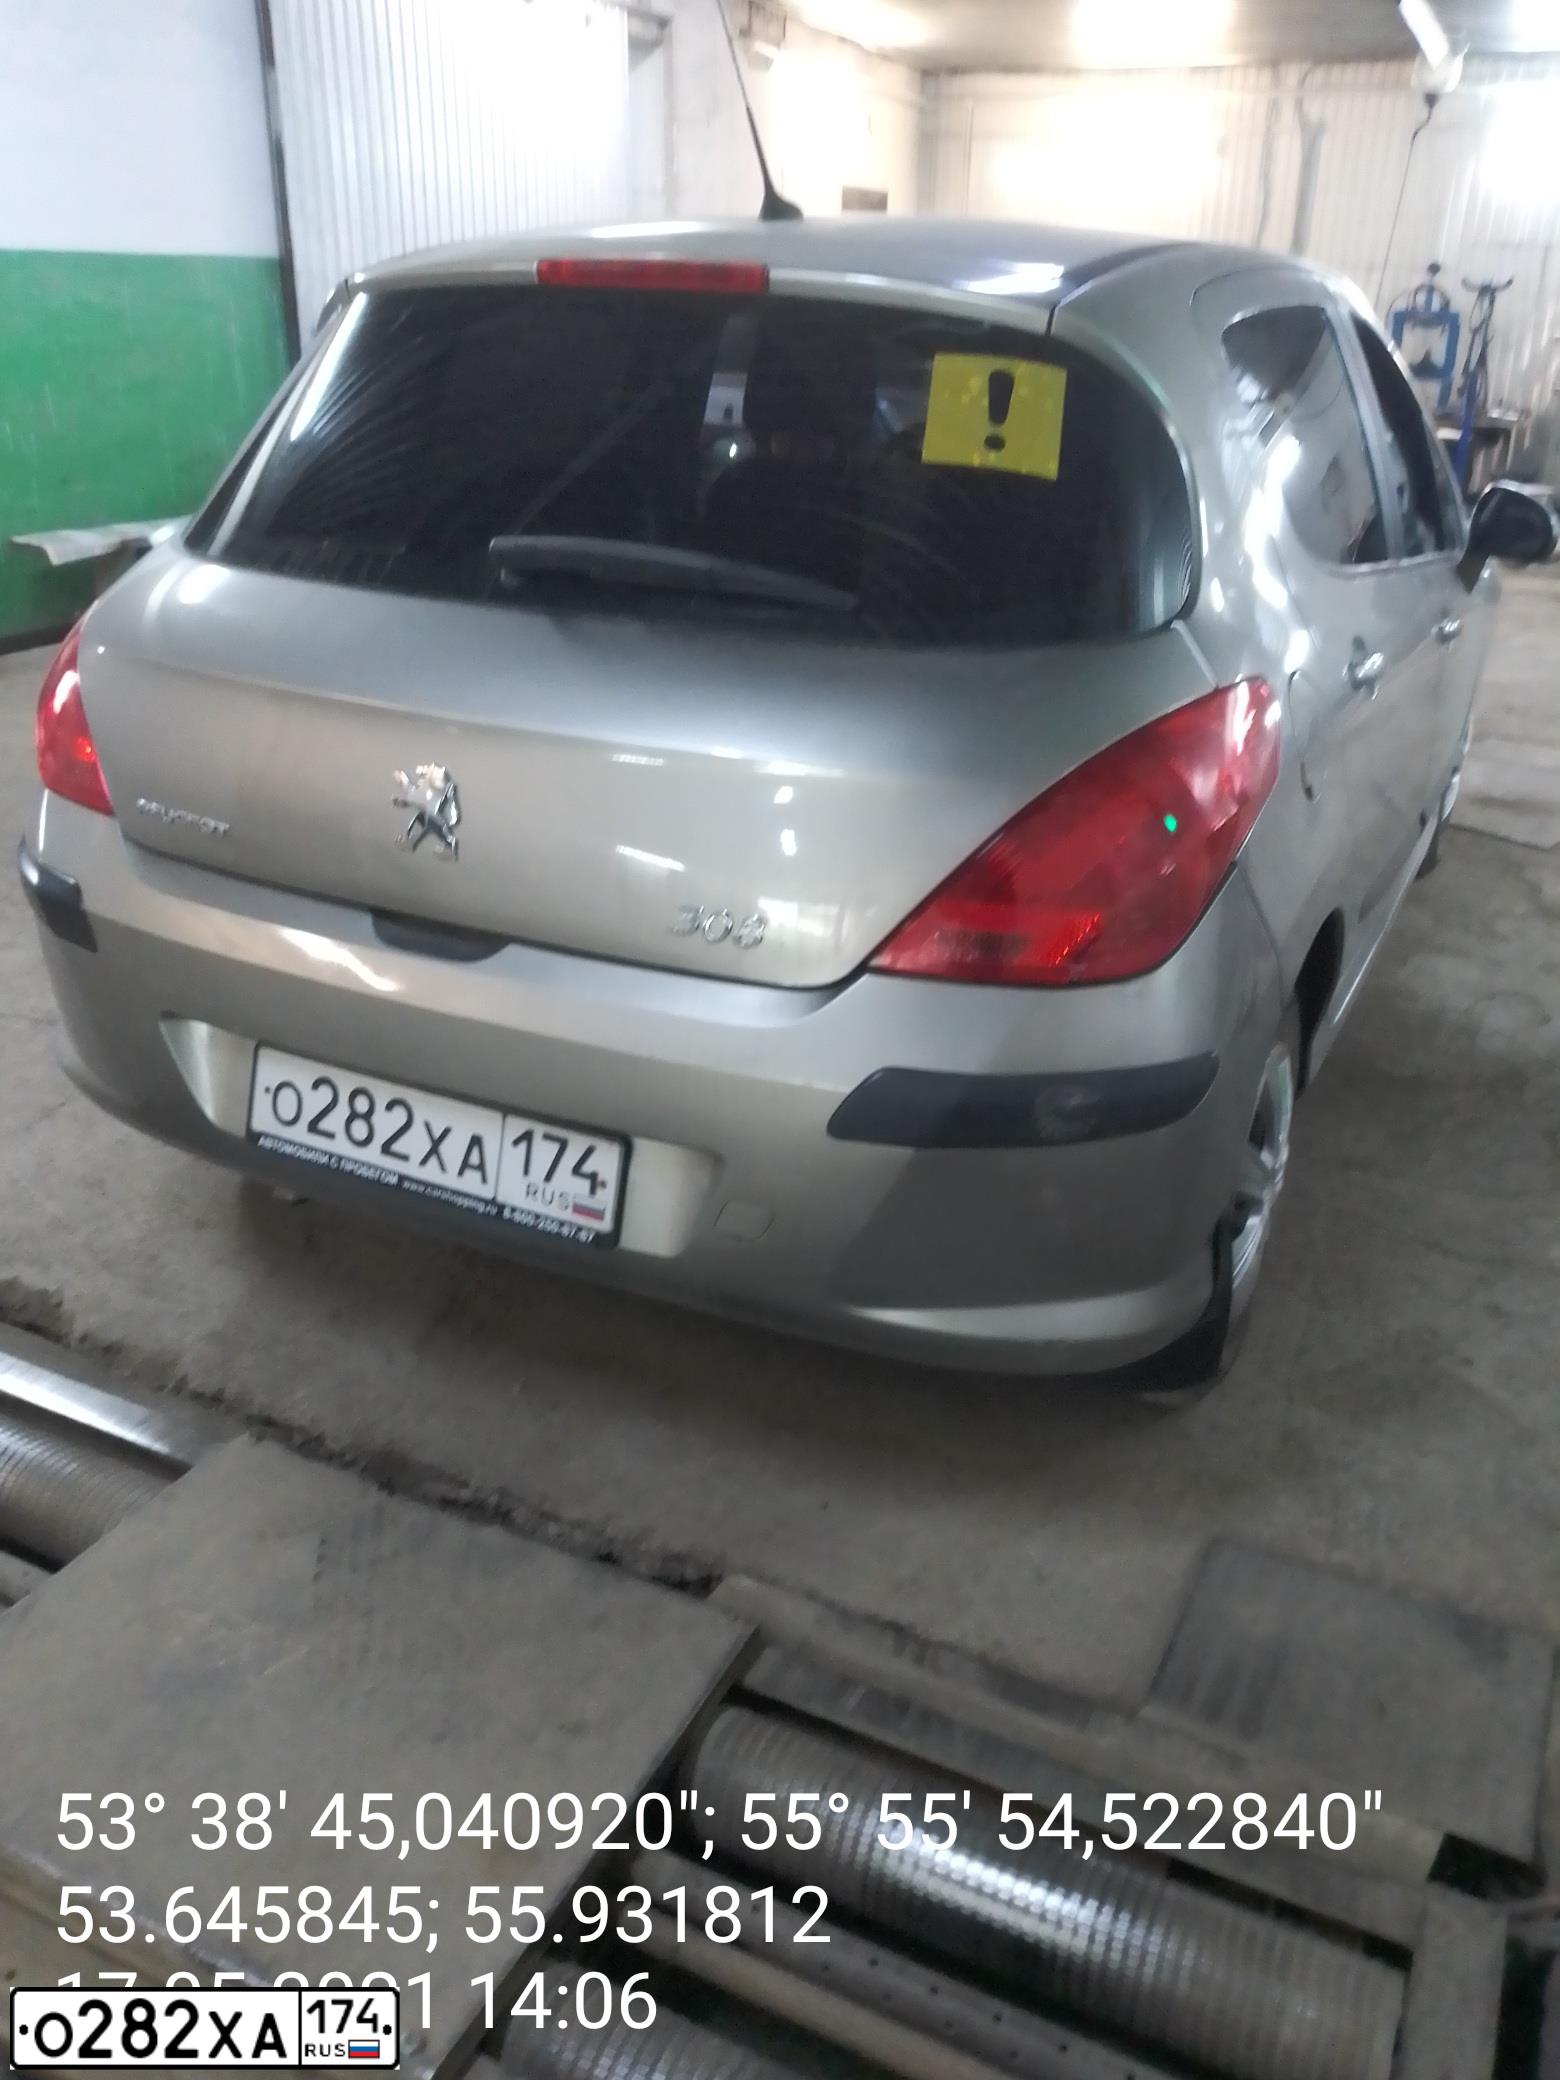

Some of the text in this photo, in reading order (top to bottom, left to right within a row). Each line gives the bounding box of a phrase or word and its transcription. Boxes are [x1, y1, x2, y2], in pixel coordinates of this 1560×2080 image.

[672, 904, 767, 949] 308
[512, 1129, 598, 1196] 174
[526, 1182, 570, 1211] RUS
